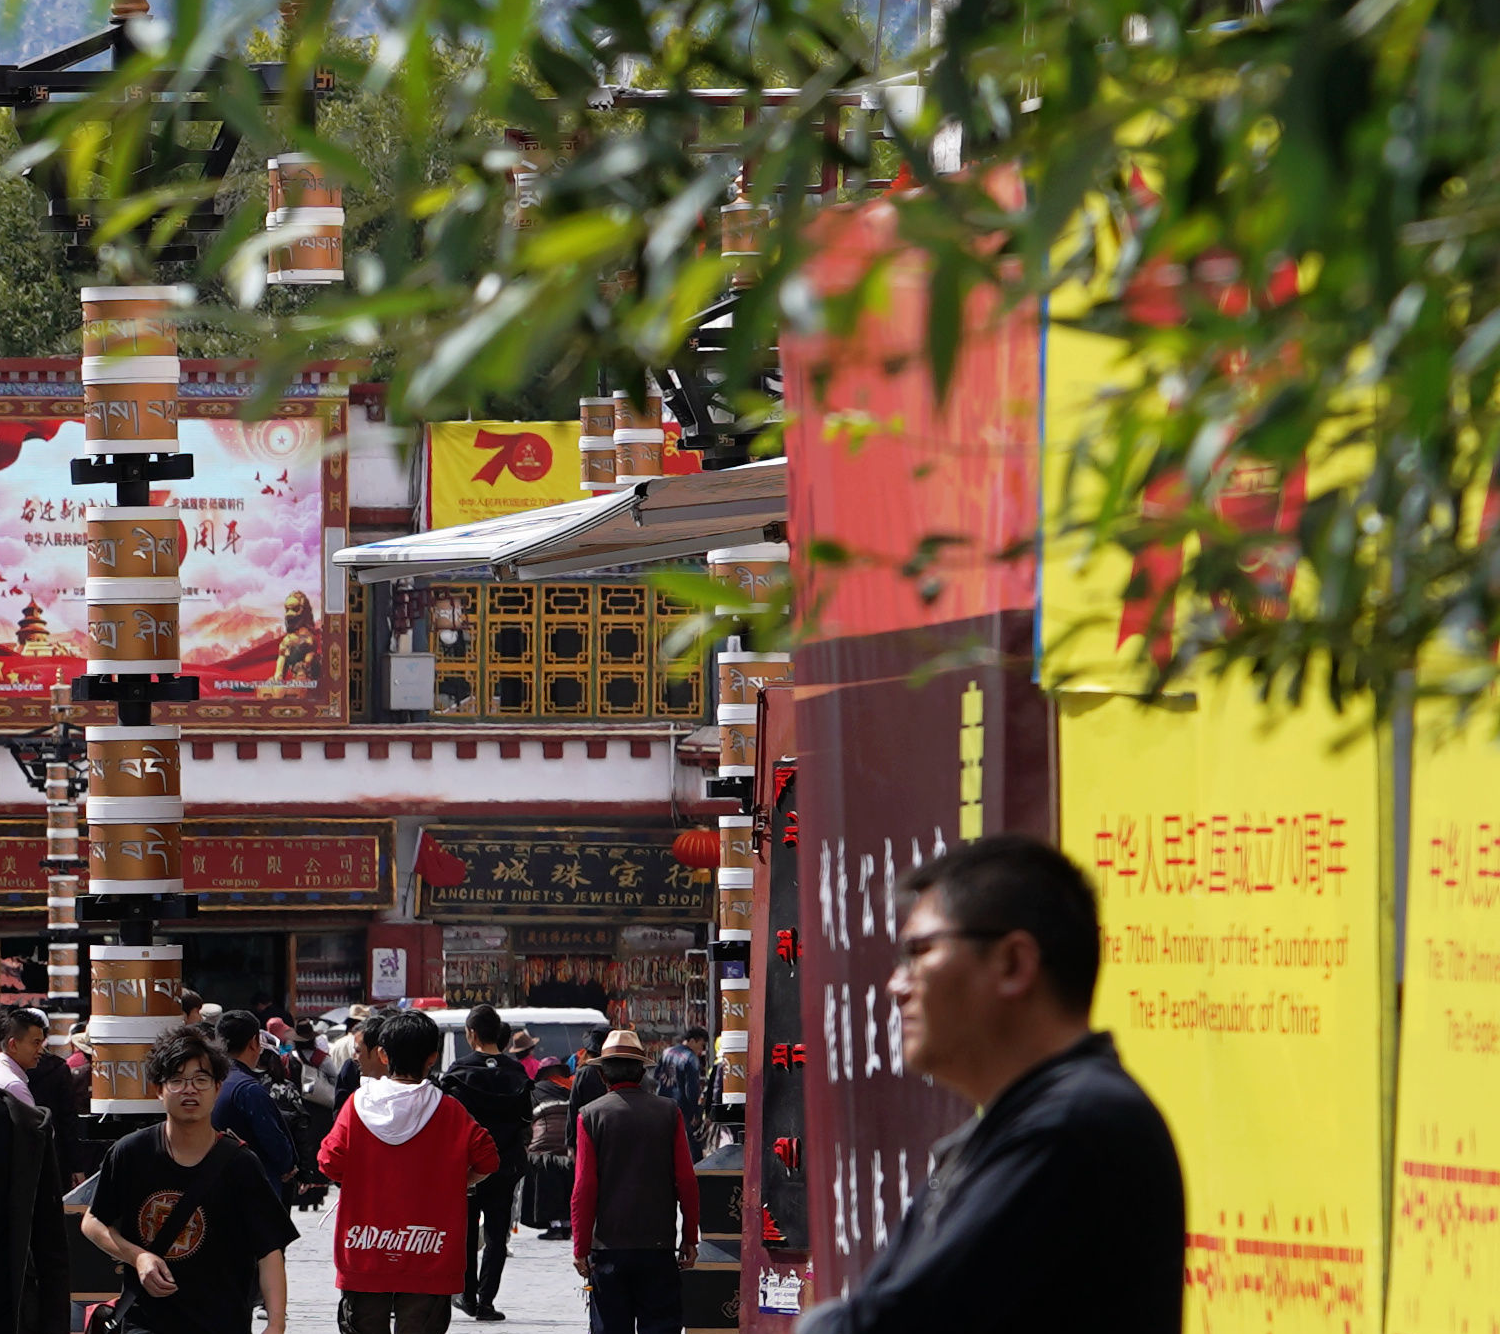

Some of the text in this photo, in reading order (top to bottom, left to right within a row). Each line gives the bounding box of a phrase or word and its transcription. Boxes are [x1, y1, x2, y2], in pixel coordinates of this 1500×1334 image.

[20, 498, 112, 522] 奋进新时
[212, 877, 260, 889] company
[437, 887, 701, 905] ANCIENT TIBET'S JEWELRY SHOP
[1279, 993, 1321, 1035] China
